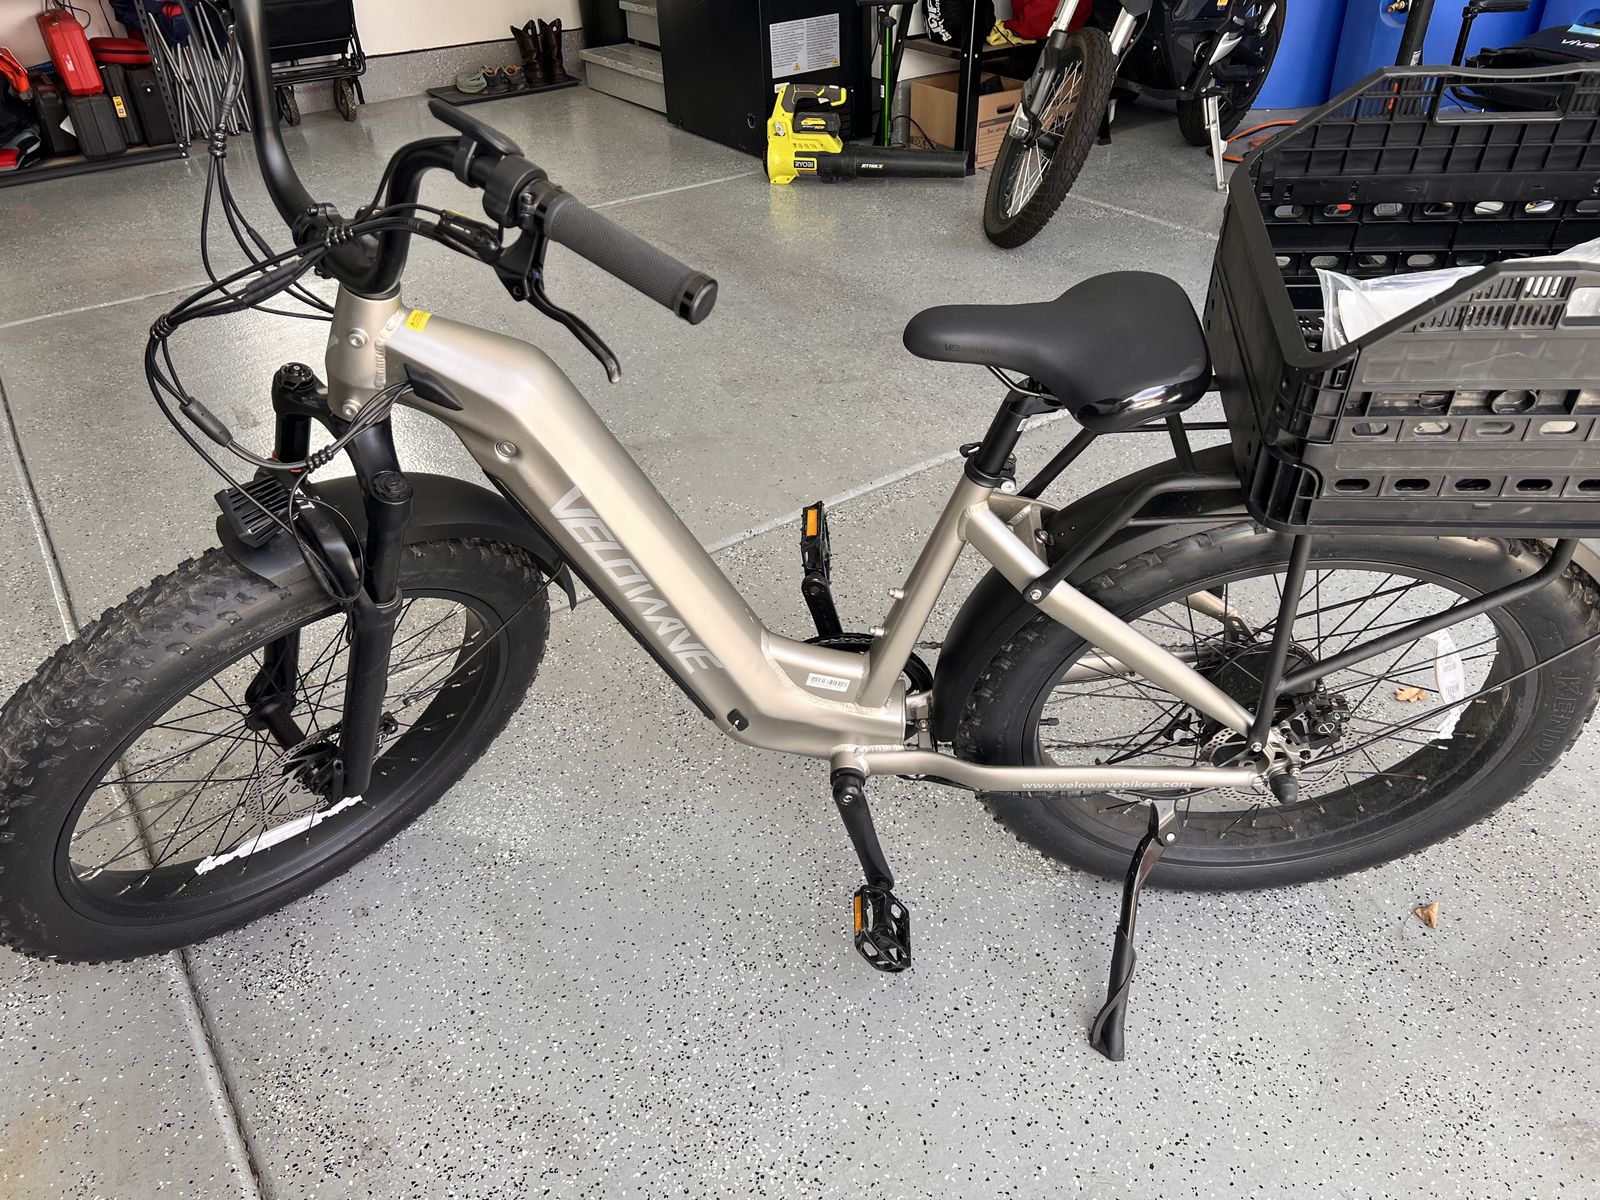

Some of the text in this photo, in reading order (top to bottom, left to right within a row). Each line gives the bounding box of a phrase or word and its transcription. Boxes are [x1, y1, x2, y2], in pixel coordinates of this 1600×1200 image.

[550, 484, 726, 675] VELOWAVE
[1519, 676, 1582, 766] KENDA
[1022, 781, 1192, 789] www.velowavebikes.com
